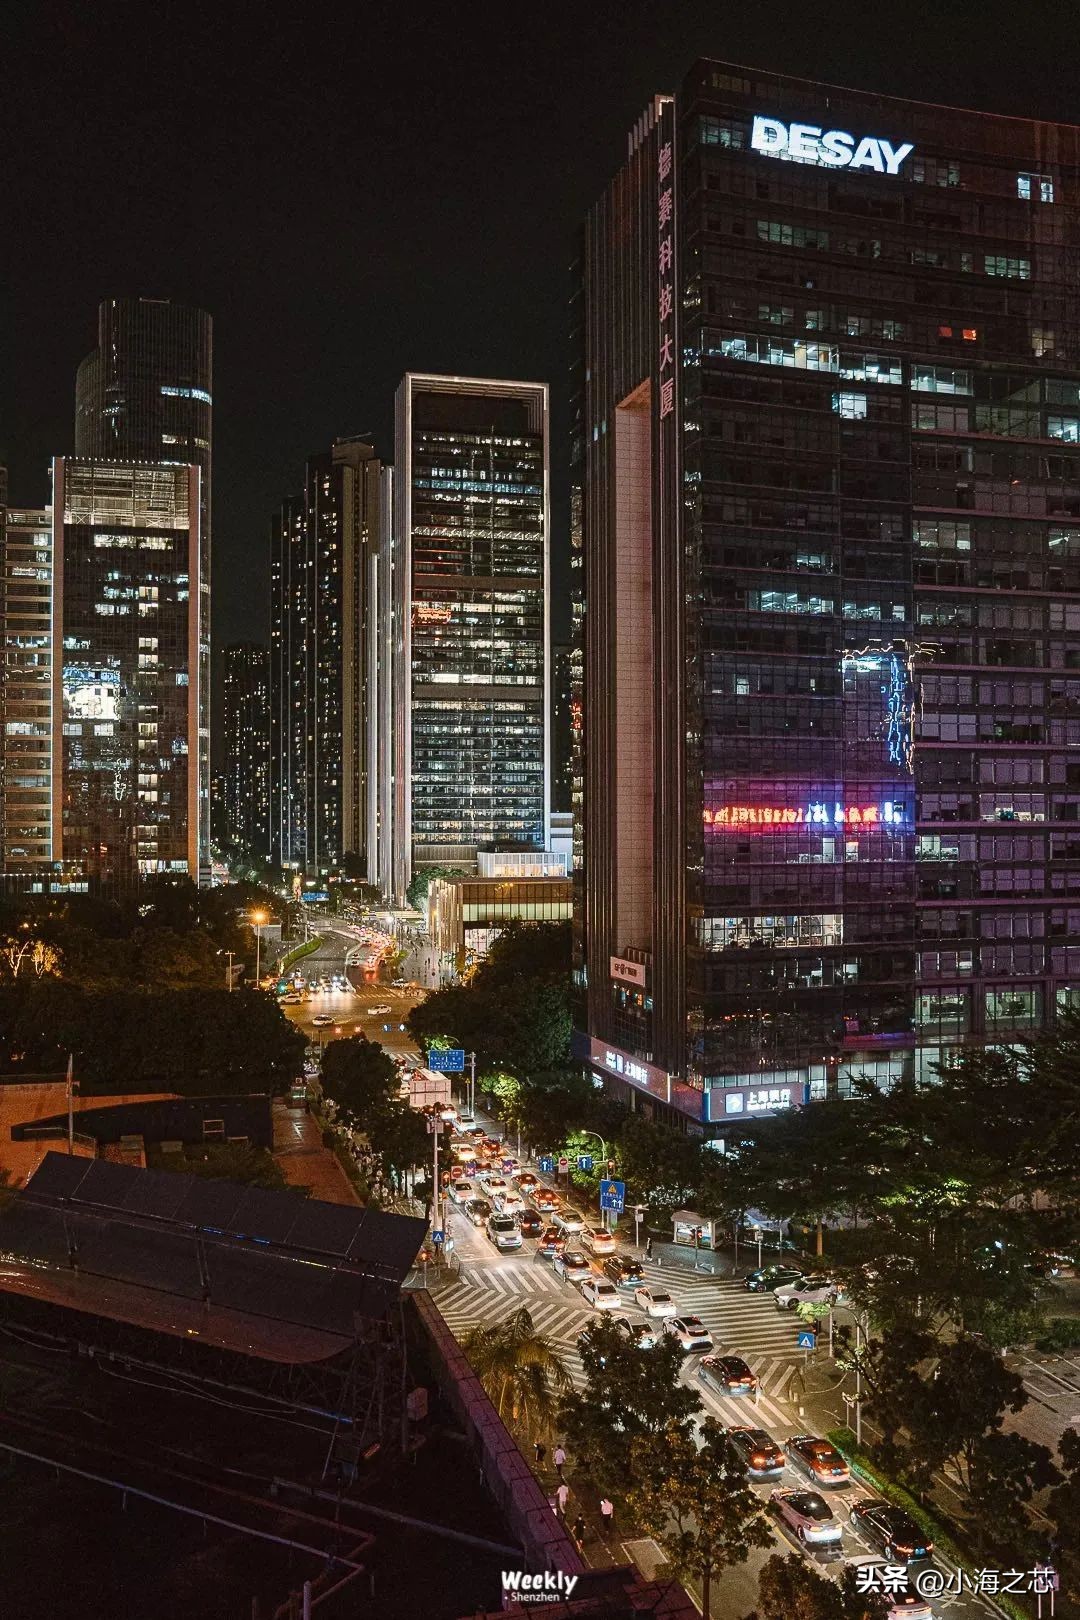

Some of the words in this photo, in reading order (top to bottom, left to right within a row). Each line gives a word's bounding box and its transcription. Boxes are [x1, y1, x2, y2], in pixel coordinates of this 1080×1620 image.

[751, 115, 914, 174] DESAY
[658, 141, 674, 419] 德赛科技大厦
